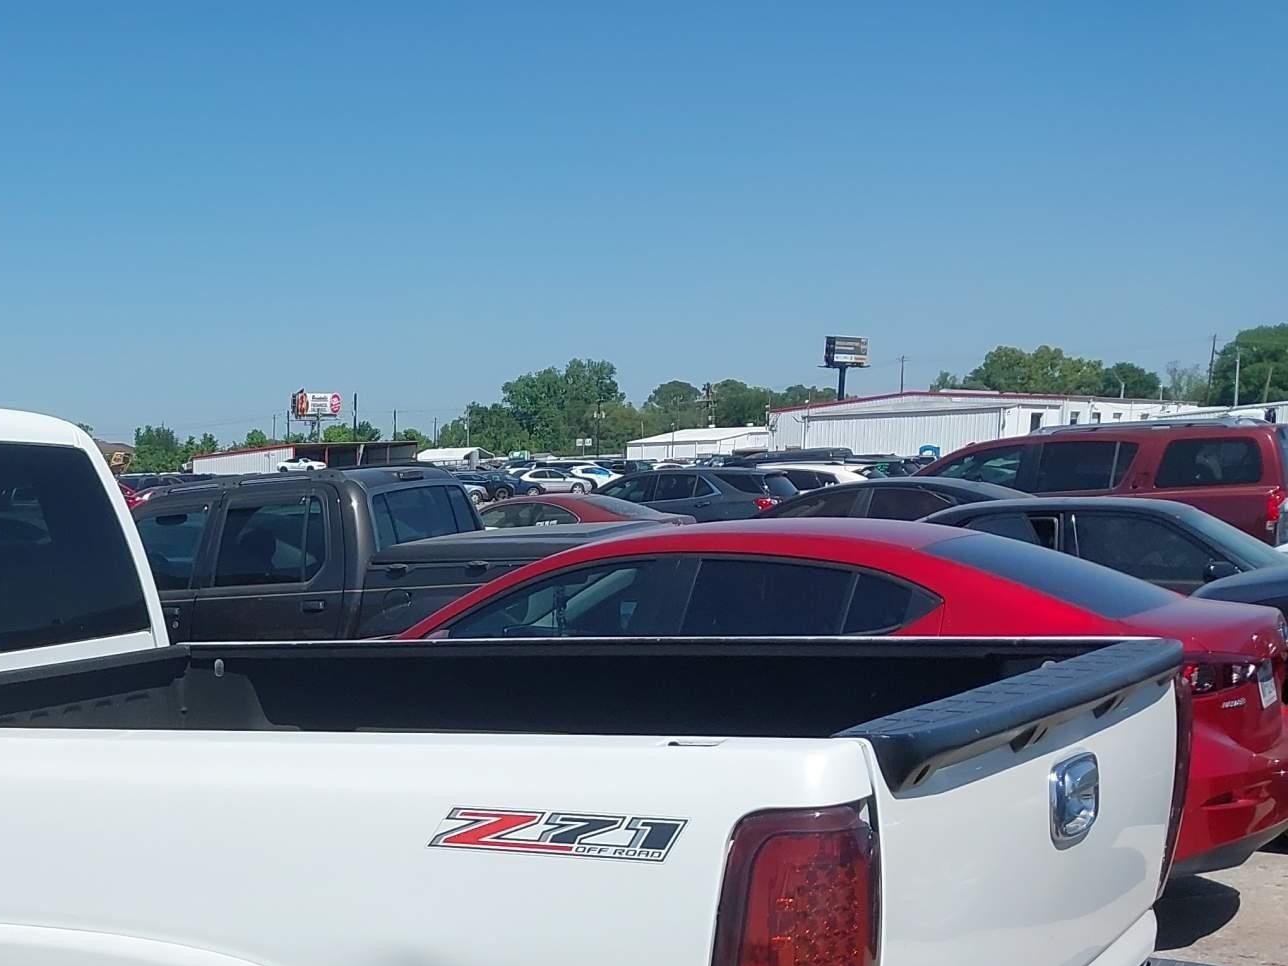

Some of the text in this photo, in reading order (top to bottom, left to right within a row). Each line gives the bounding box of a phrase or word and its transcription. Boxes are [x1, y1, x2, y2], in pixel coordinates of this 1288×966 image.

[427, 808, 689, 861] Z71
[574, 846, 662, 859] OFF ROAD
